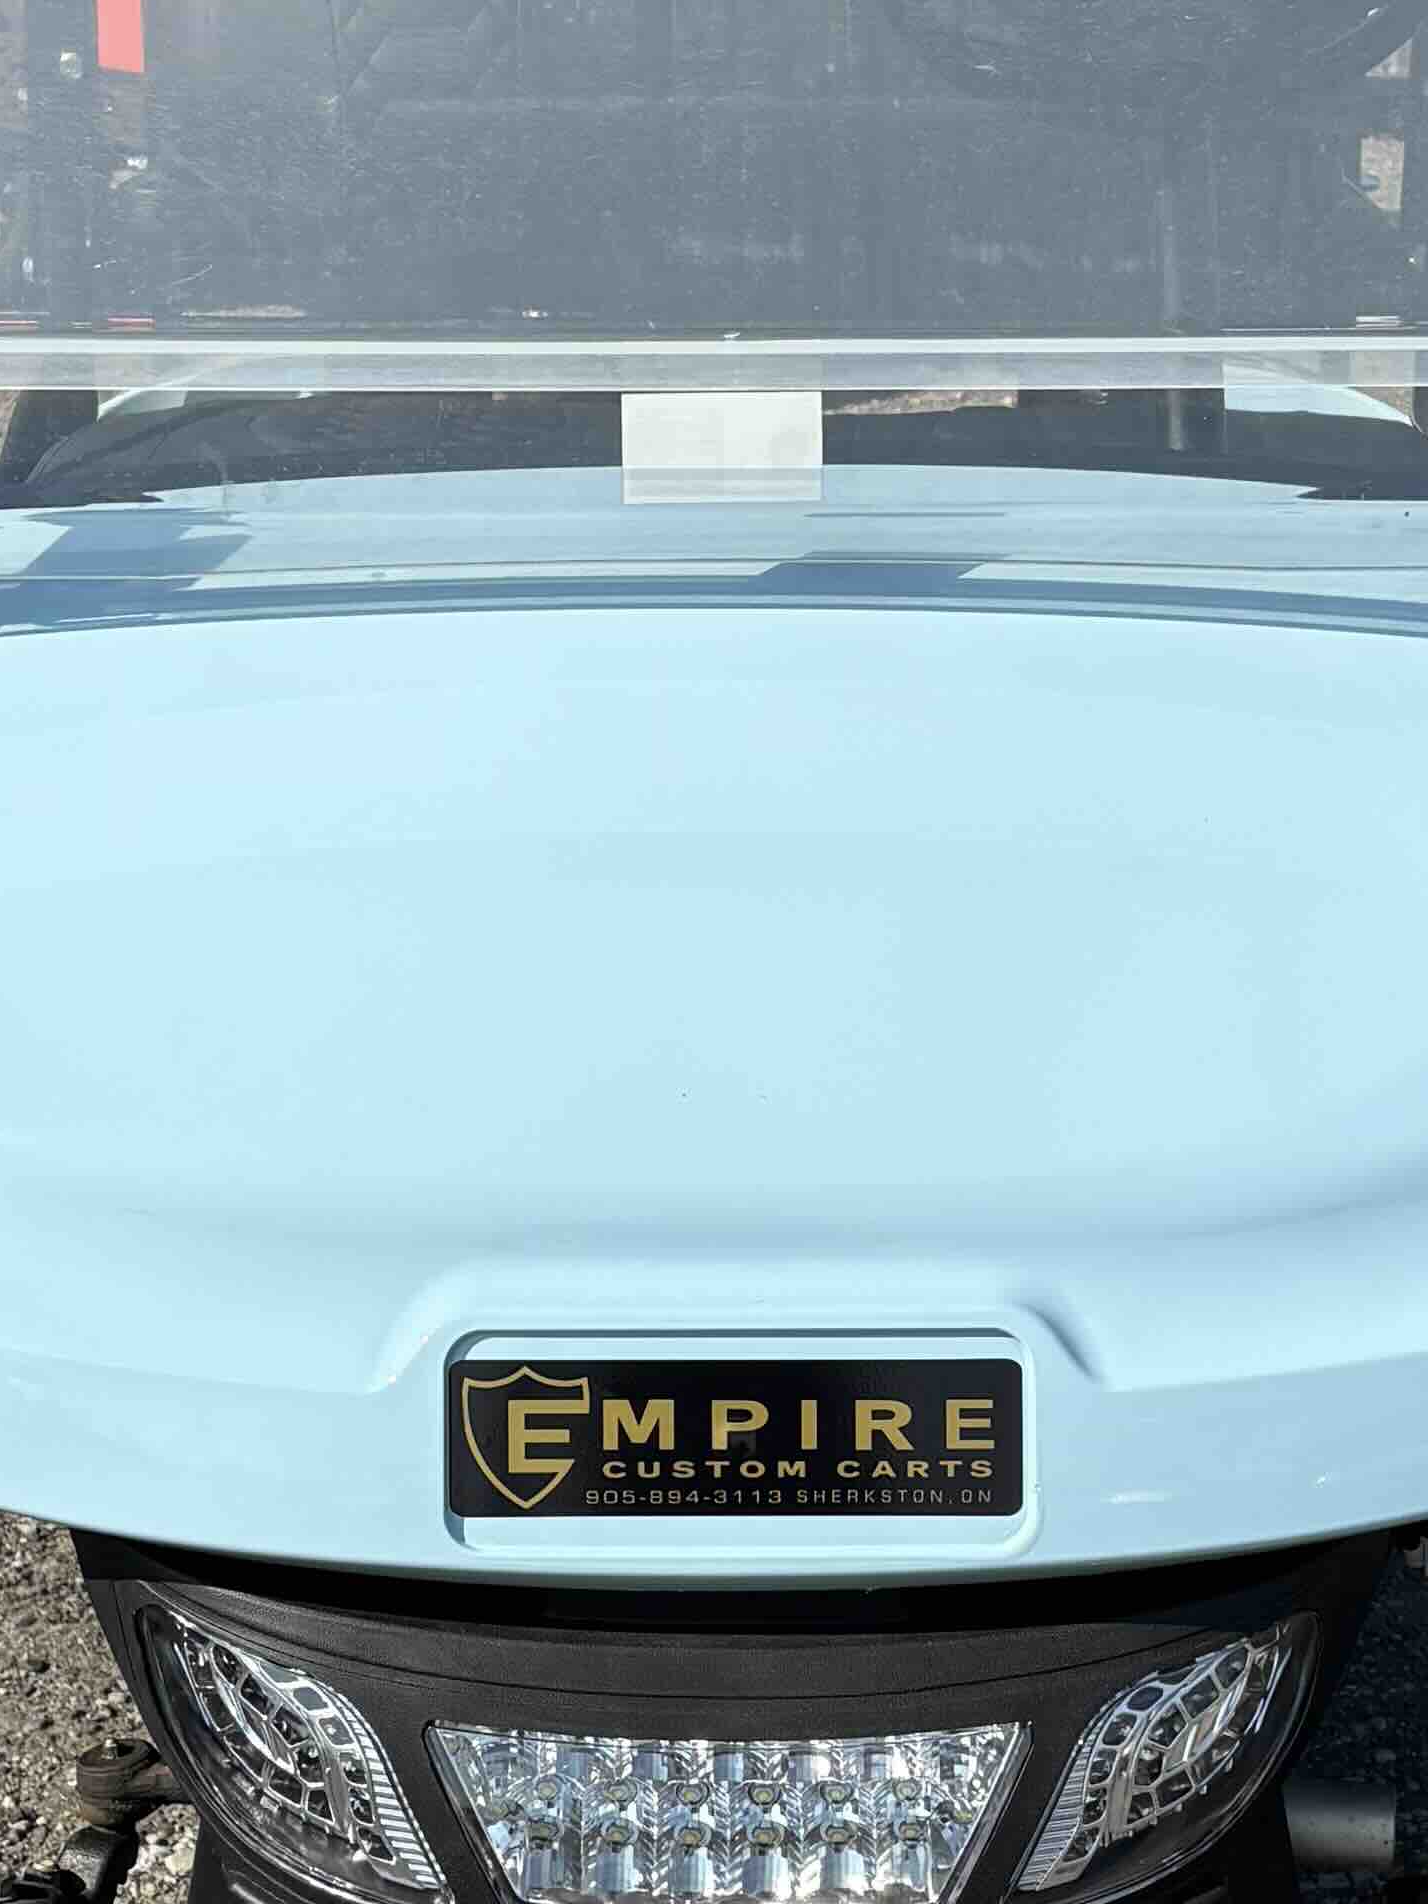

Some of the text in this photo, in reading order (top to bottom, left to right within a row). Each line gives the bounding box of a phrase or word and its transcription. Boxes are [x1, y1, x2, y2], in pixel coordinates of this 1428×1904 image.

[508, 1399, 995, 1474] EMPIRE
[603, 1460, 993, 1478] CUSTOM CARTS
[586, 1490, 781, 1504] 905-894-3113
